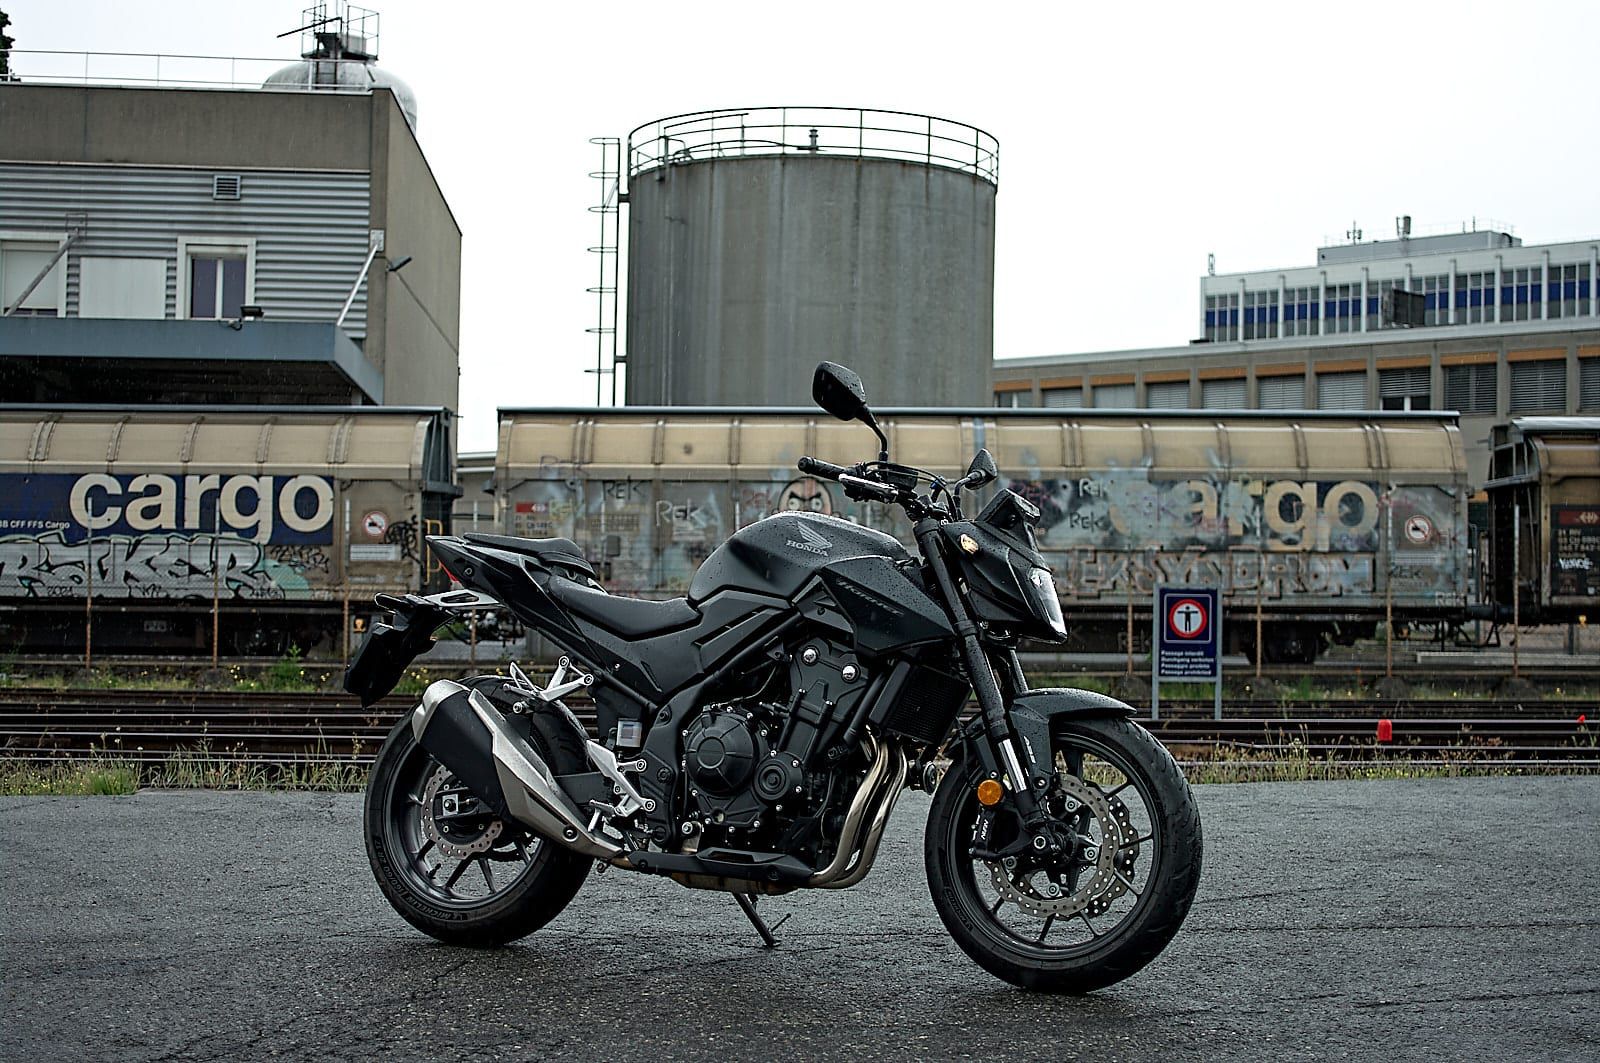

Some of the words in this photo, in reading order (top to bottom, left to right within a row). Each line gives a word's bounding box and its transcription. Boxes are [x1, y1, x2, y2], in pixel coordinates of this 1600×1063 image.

[69, 473, 334, 545] cargo
[10, 520, 25, 528] CFF
[27, 520, 44, 528] FFS
[45, 520, 70, 531] Cargo
[786, 539, 829, 557] HONDA
